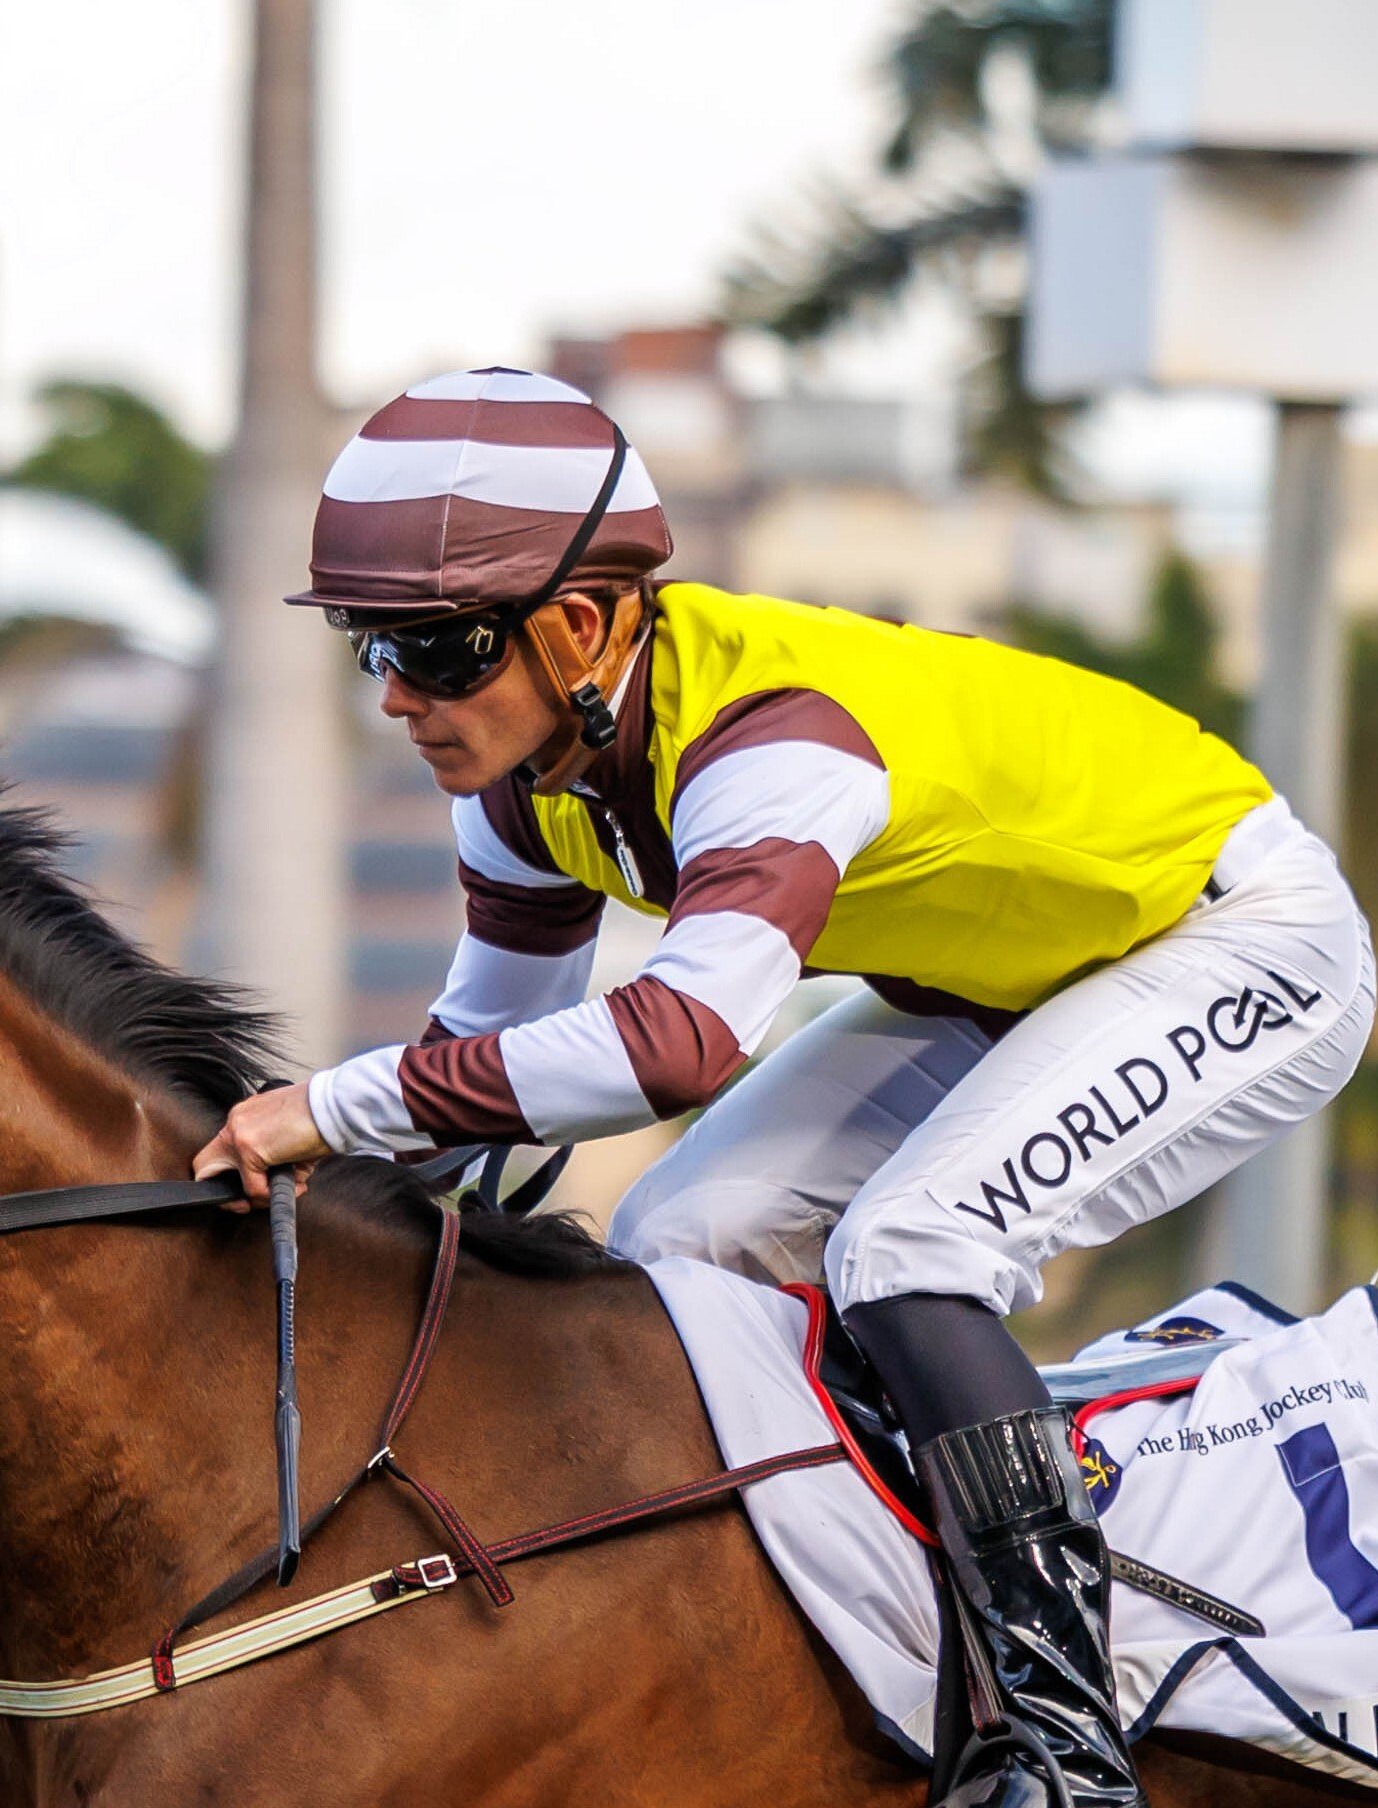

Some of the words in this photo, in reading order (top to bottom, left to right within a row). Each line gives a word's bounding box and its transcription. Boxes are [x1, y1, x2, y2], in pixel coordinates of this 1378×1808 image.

[954, 1057, 1169, 1234] WORLD
[1165, 971, 1322, 1083] POOL
[1206, 1416, 1263, 1446] Kong
[1259, 1380, 1333, 1430] Jockey
